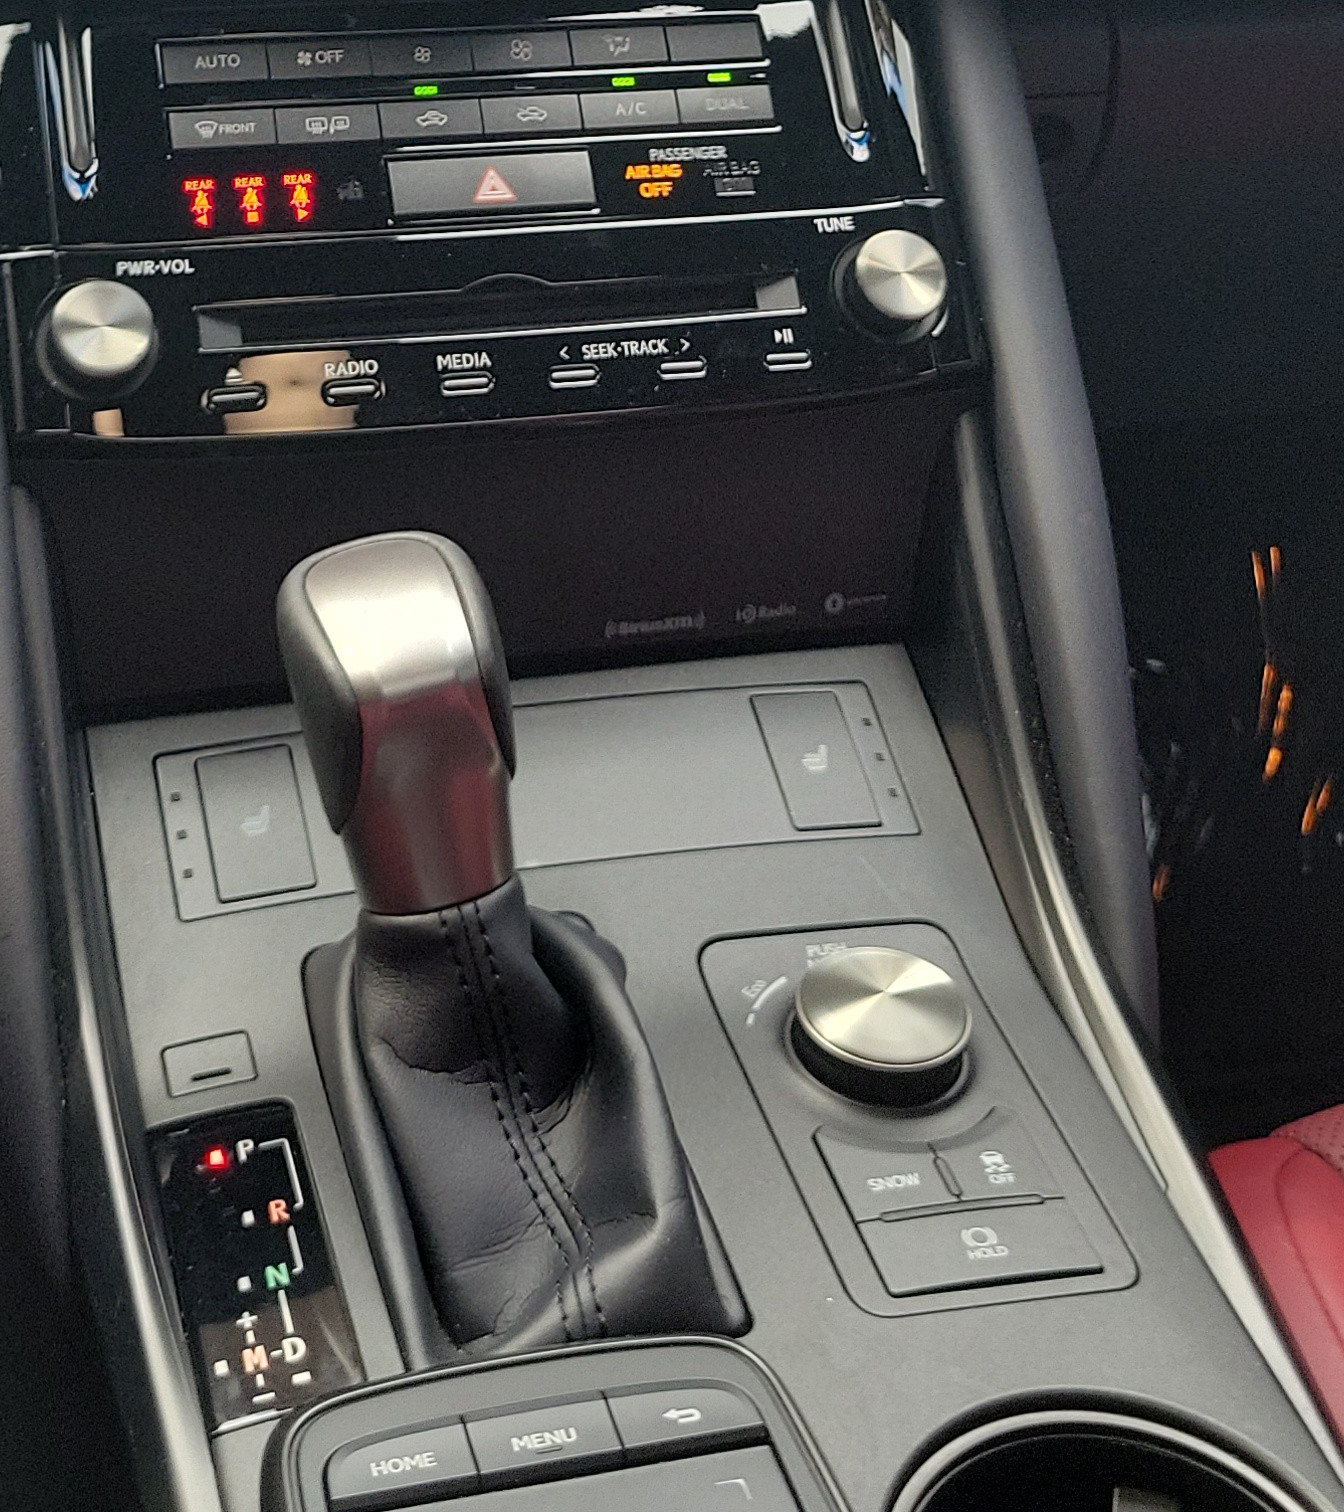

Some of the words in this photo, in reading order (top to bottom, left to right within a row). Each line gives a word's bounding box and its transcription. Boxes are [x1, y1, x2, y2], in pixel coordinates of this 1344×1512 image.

[195, 53, 242, 70] AUTO
[315, 49, 345, 64] OFF
[218, 121, 257, 135] FRONT
[614, 101, 648, 117] A/C
[648, 145, 729, 162] PASSENGER
[282, 173, 313, 186] REAR
[625, 165, 650, 180] AIR
[652, 163, 683, 179] BAG
[184, 178, 216, 191] REAR
[233, 176, 264, 189] REAR
[637, 181, 674, 199] OFF
[813, 215, 856, 233] TUNE
[324, 359, 379, 378] RADIO
[435, 351, 492, 372] MEDIA
[234, 1137, 255, 1165] P
[865, 1170, 922, 1192] SNOW
[986, 1171, 1017, 1186] OFF
[267, 1198, 292, 1226] R
[967, 1244, 1010, 1261] HOLD
[264, 1261, 291, 1291] N
[241, 1344, 271, 1376] M
[283, 1335, 308, 1364] D
[510, 1424, 578, 1453] MENU
[369, 1449, 438, 1478] HOME
